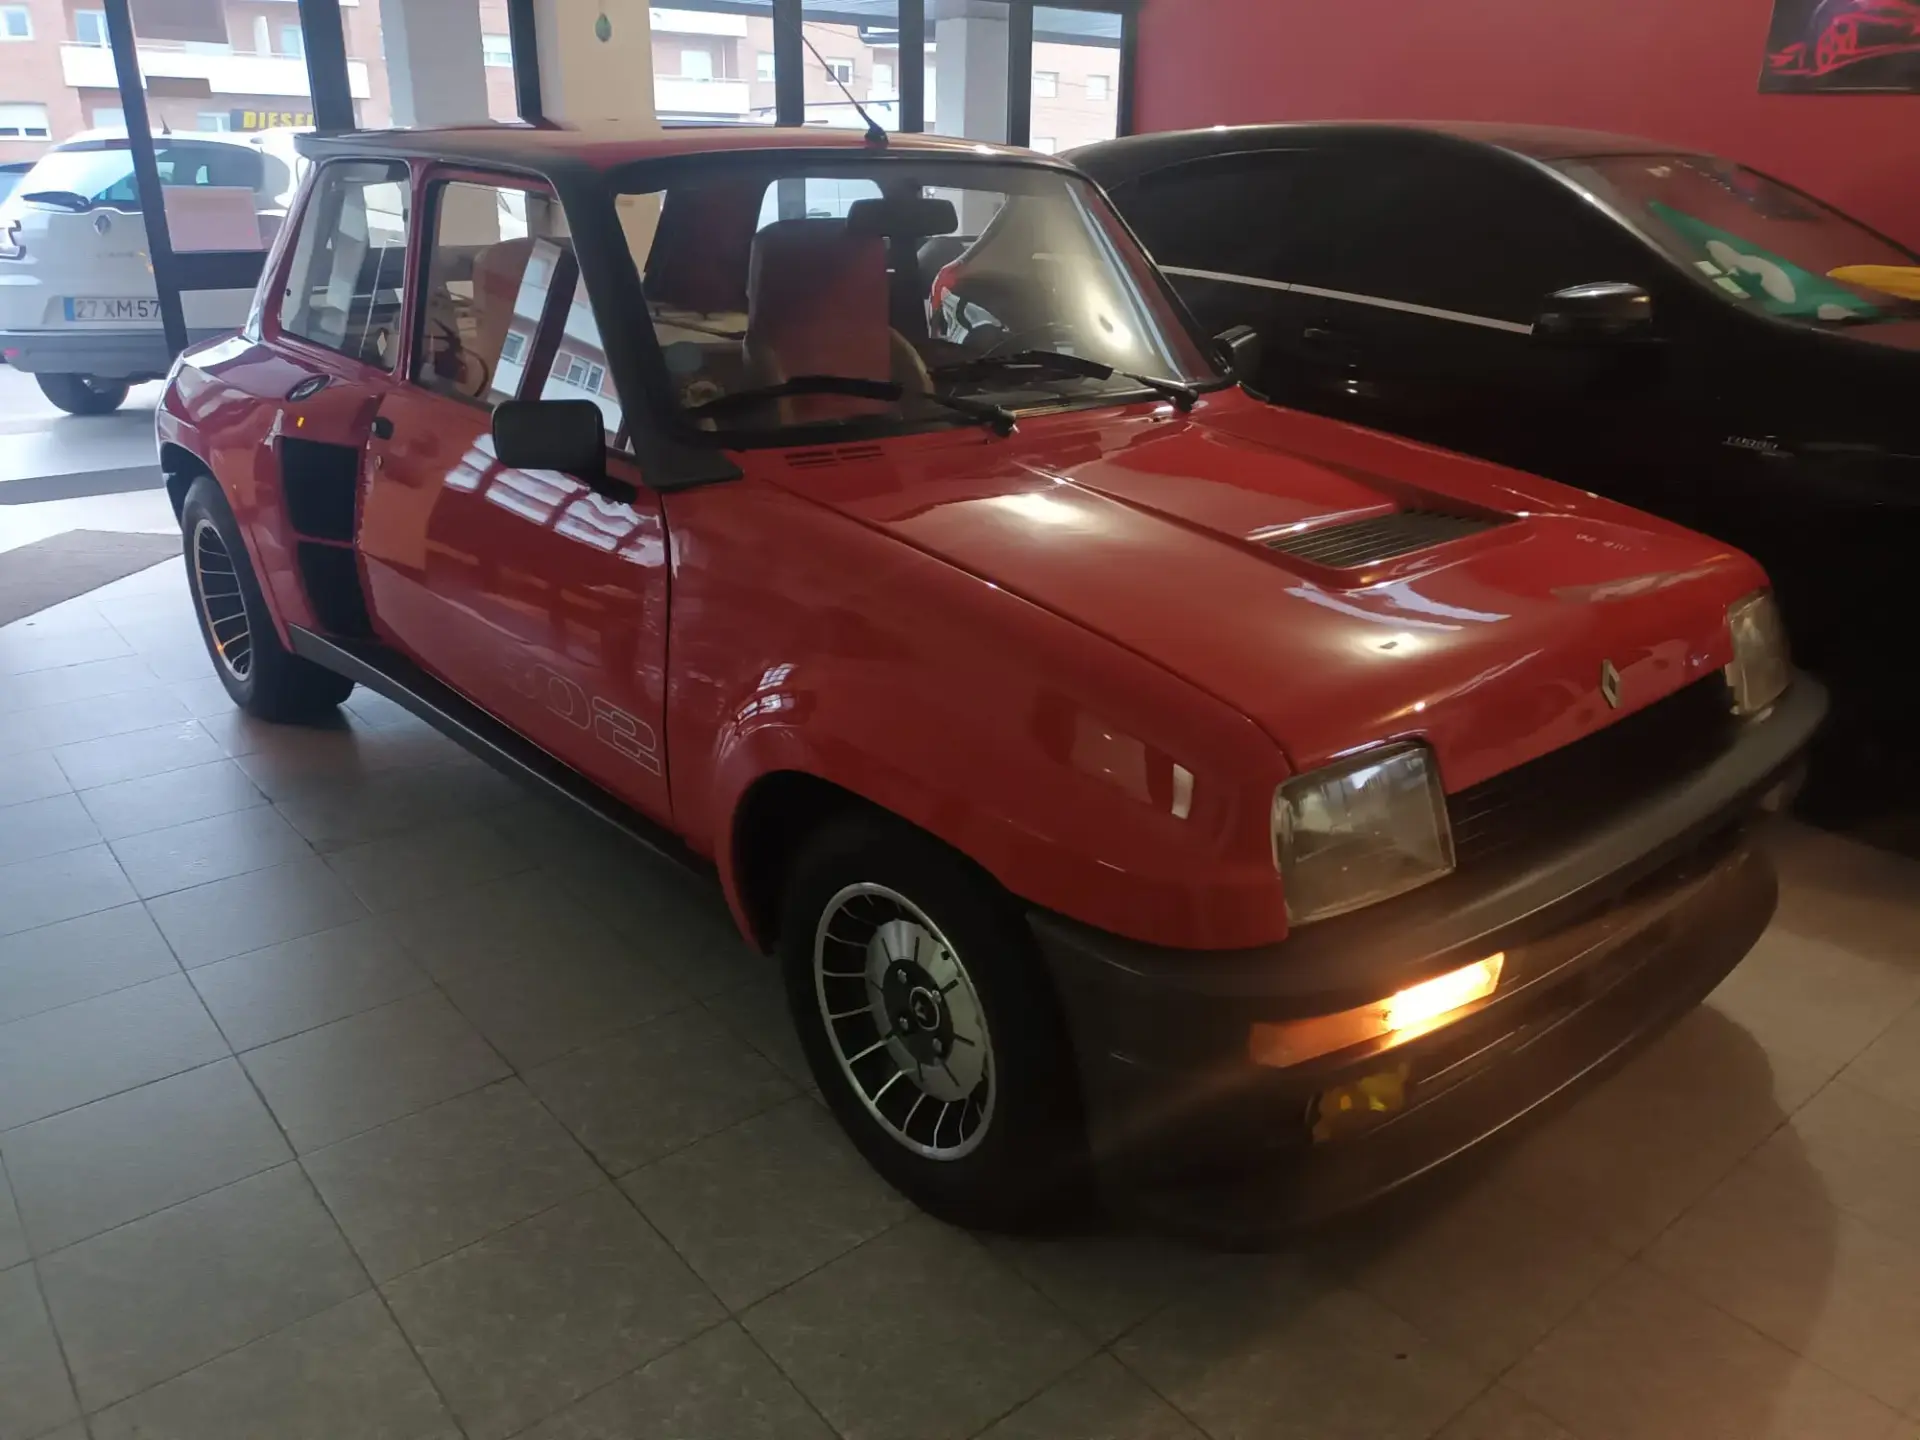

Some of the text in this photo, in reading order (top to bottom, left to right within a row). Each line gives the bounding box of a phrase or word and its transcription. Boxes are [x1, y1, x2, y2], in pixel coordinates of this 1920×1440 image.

[76, 300, 160, 319] 27 XM 57
